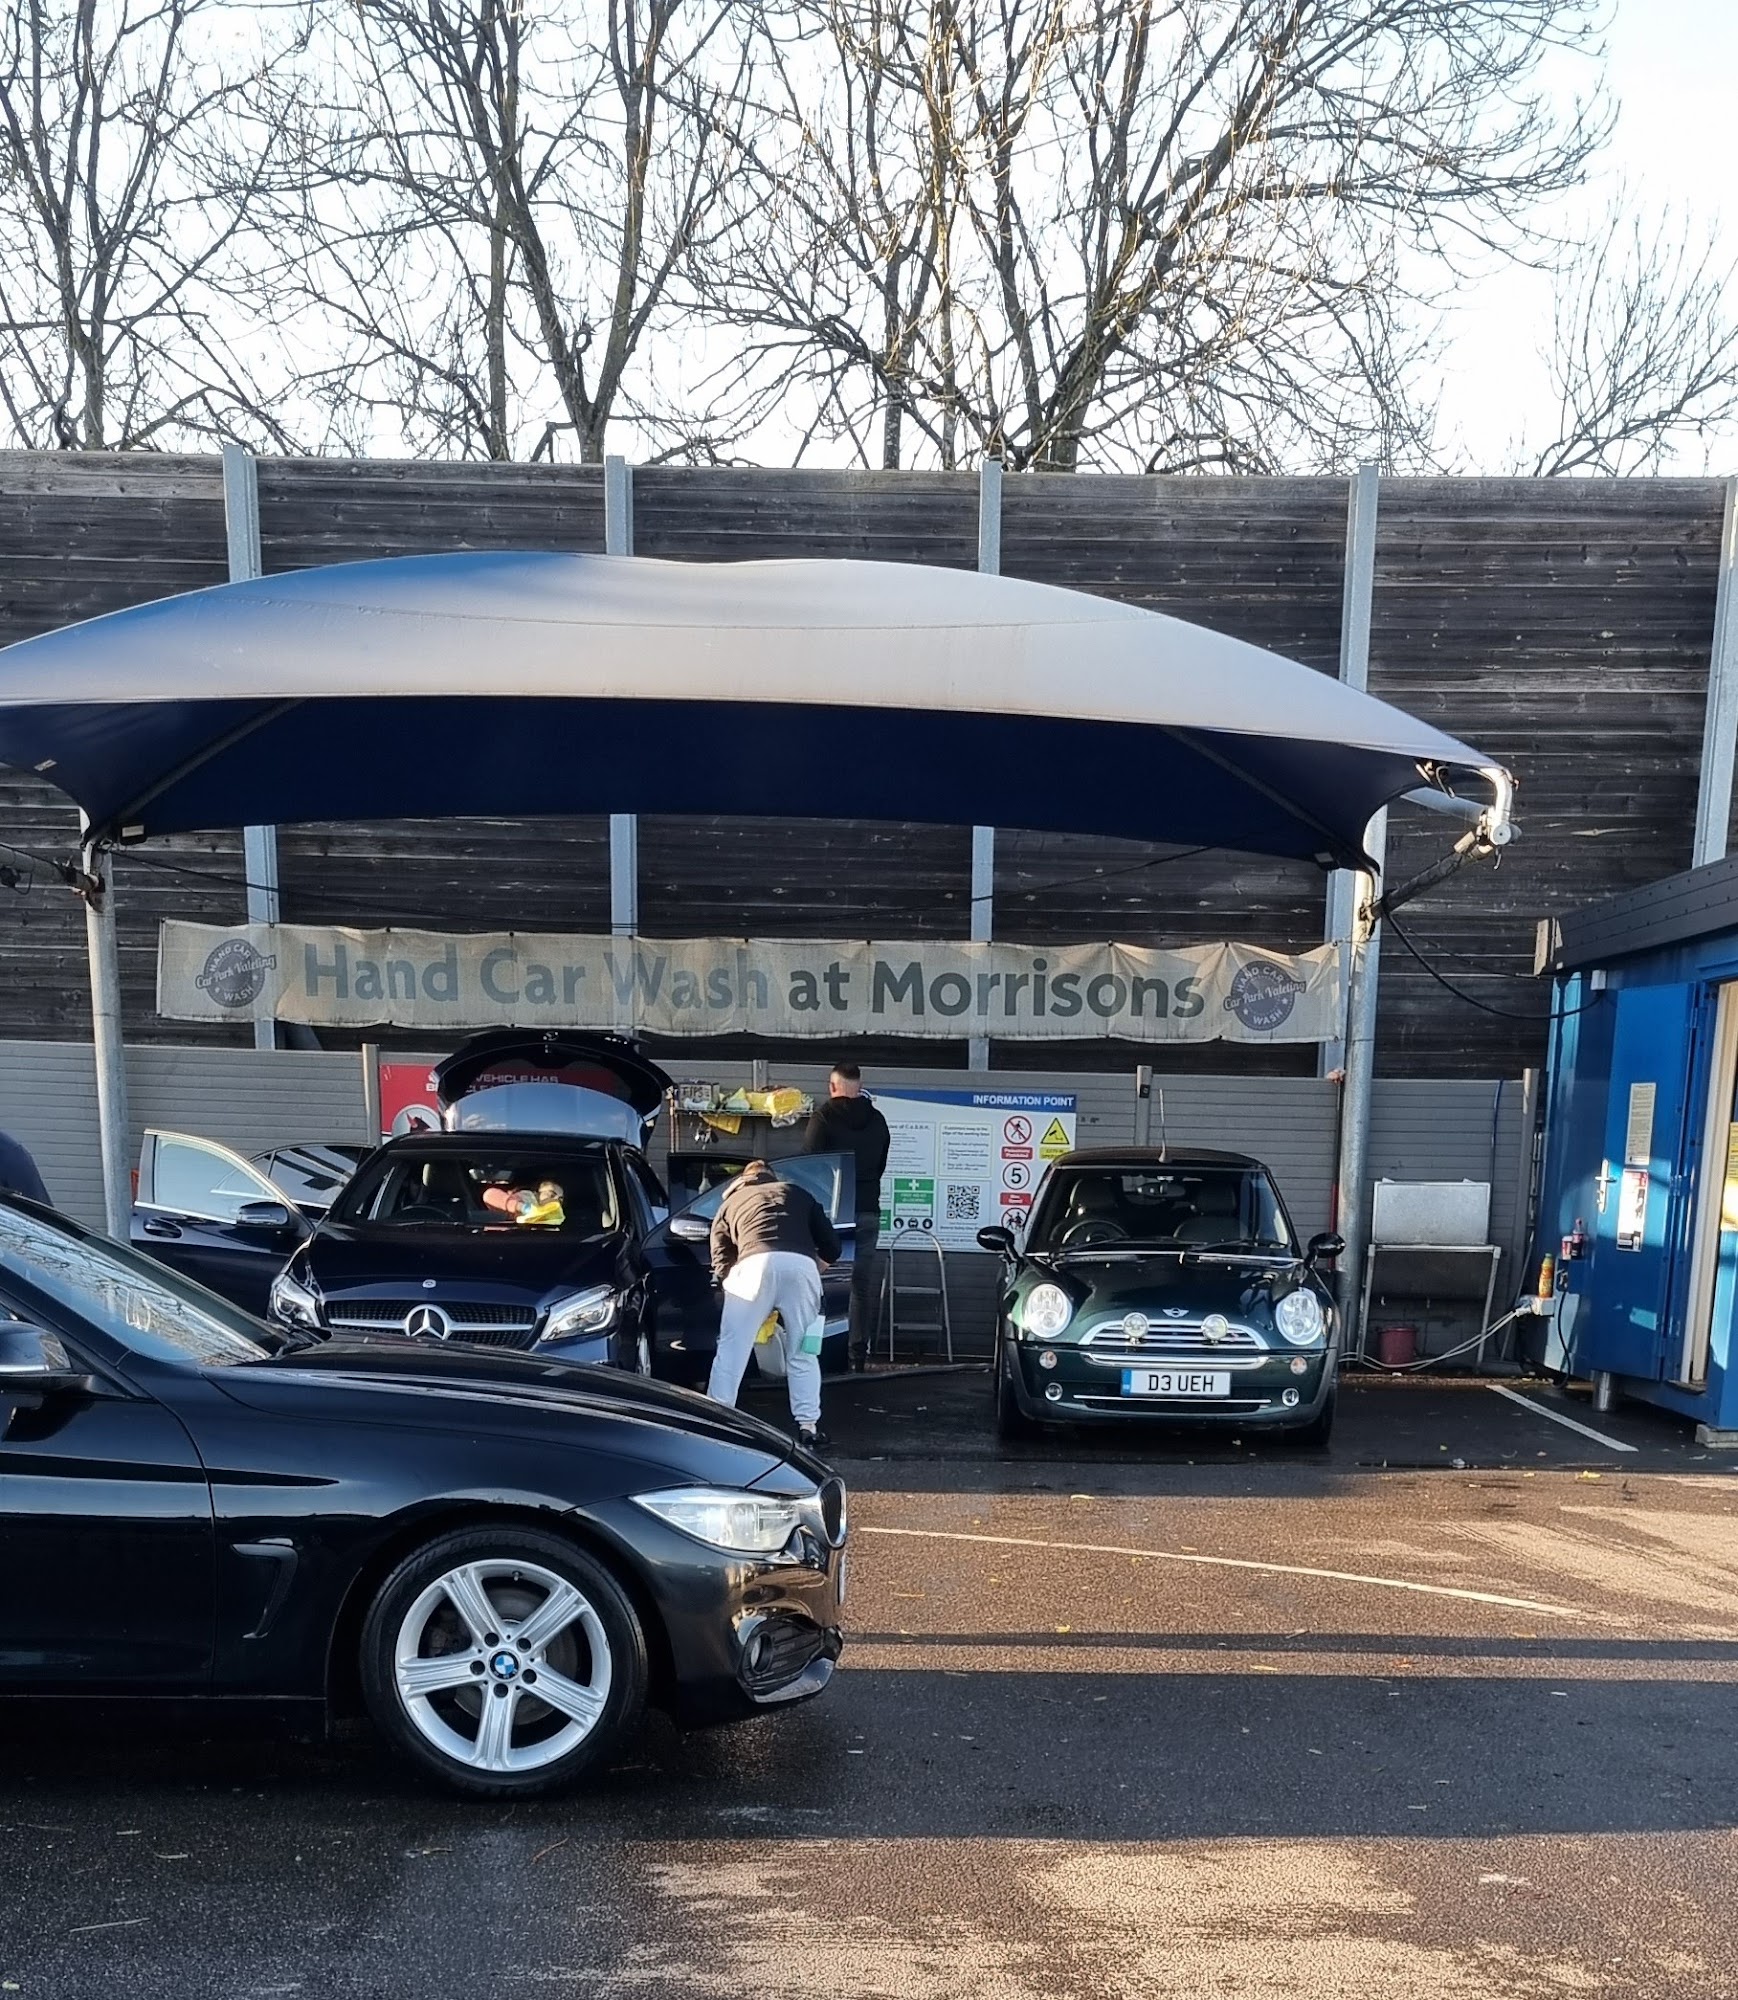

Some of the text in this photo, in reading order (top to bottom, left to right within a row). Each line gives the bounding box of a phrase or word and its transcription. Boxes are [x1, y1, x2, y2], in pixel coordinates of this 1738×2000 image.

[209, 944, 251, 972] HAND CAR
[196, 956, 275, 987] Car Park Valeting
[304, 943, 1205, 1018] Hand Car Wash at Morrisons
[1237, 967, 1284, 992] HAND CAR
[224, 985, 254, 1001] WASH
[1225, 998, 1241, 1009] Car
[1242, 989, 1265, 1004] Park
[1253, 1009, 1283, 1025] WASH
[476, 1073, 528, 1084] VEHICLE
[973, 1094, 1075, 1107] INFORMATION POINT
[1011, 1167, 1022, 1184] 5
[1148, 1374, 1214, 1392] D3 UEH
